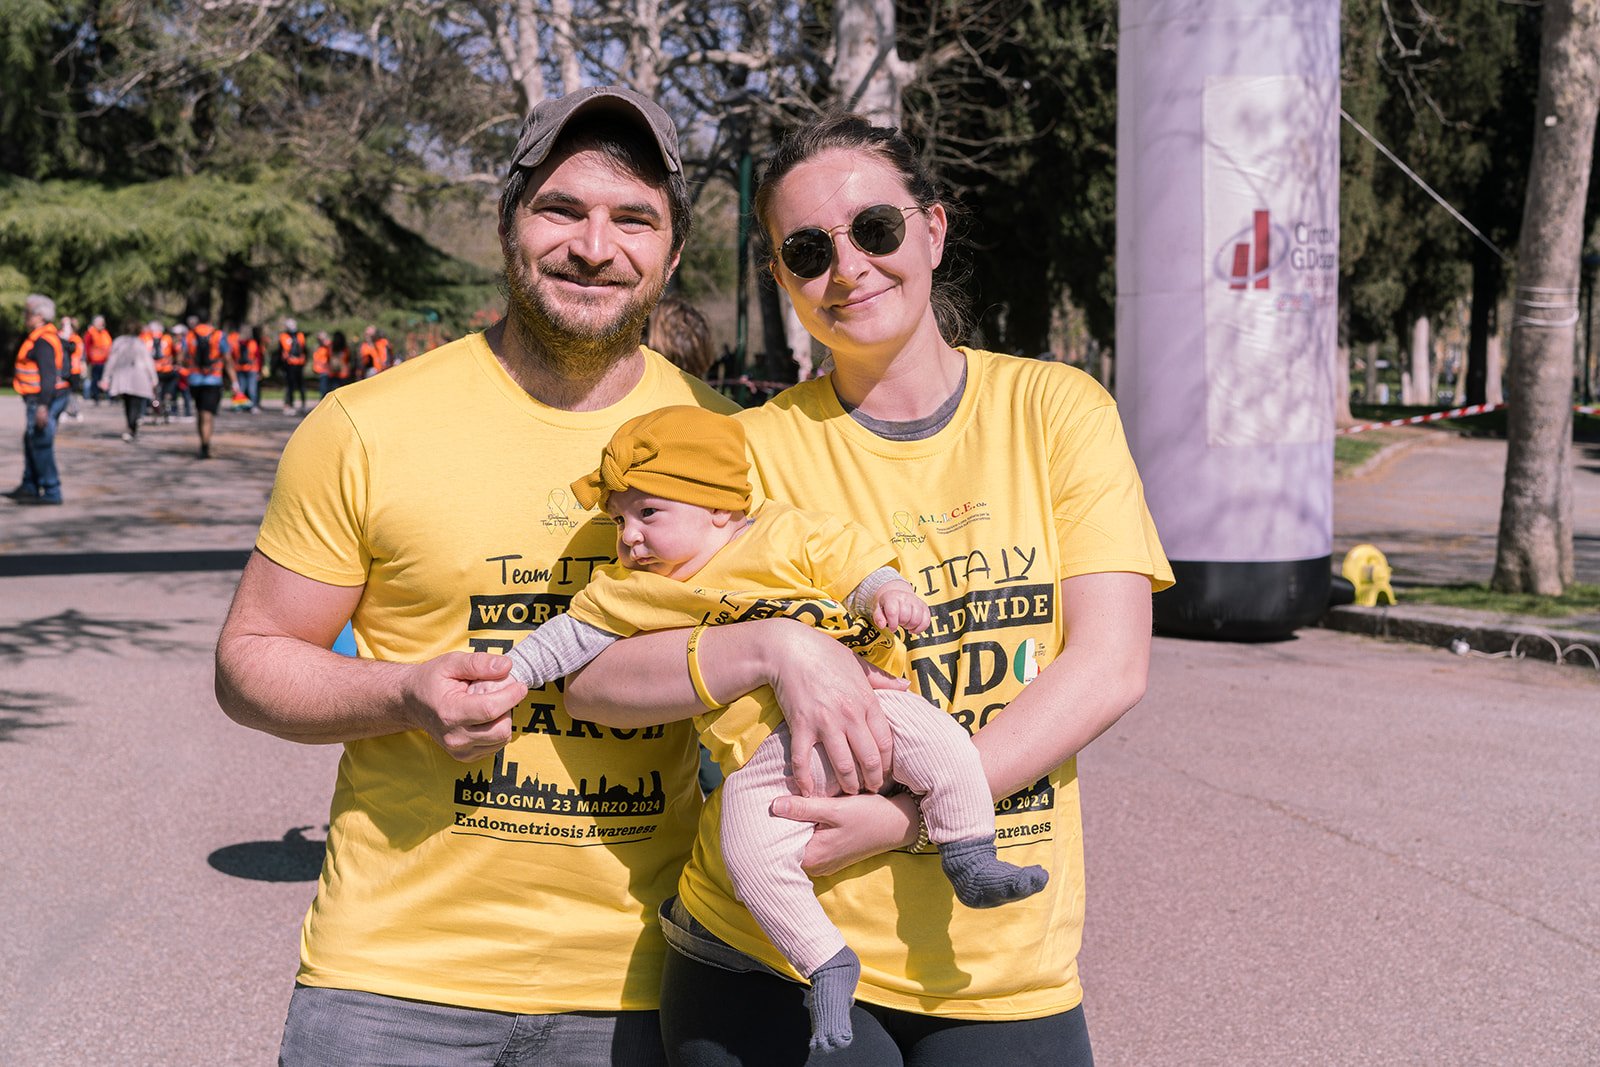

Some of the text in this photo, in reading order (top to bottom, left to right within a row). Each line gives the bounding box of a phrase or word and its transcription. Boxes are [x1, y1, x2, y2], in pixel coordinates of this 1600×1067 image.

[486, 554, 552, 585] Team
[919, 546, 1036, 596] ITALY
[910, 641, 1008, 709] ND
[462, 788, 661, 814] BOLOGNA 23 MARZO 2024
[1016, 793, 1049, 809] 2024
[454, 811, 658, 839] Endometriosis Awareness
[995, 821, 1051, 839] areness
